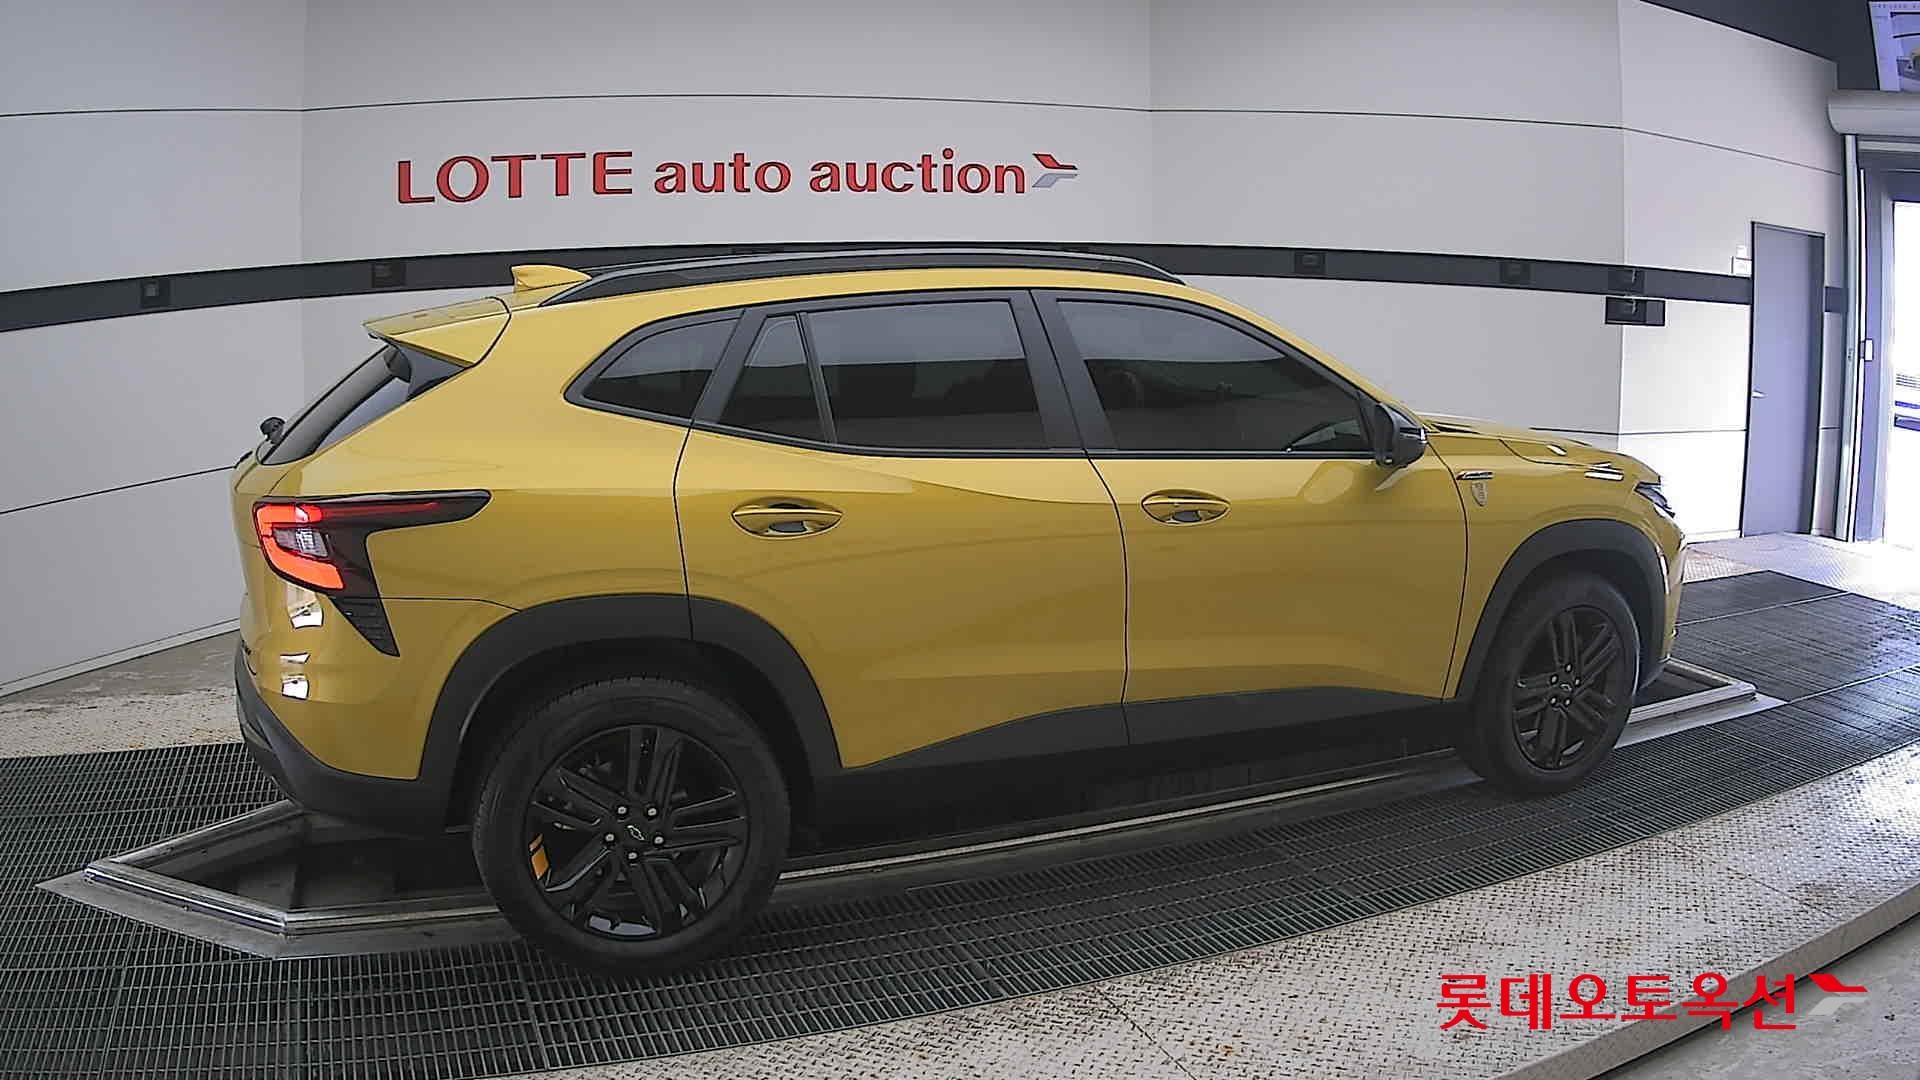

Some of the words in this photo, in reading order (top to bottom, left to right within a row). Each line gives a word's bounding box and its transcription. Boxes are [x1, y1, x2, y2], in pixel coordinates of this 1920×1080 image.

[398, 151, 632, 204] LOTTE
[654, 152, 792, 194] auto
[809, 148, 1026, 194] auction
